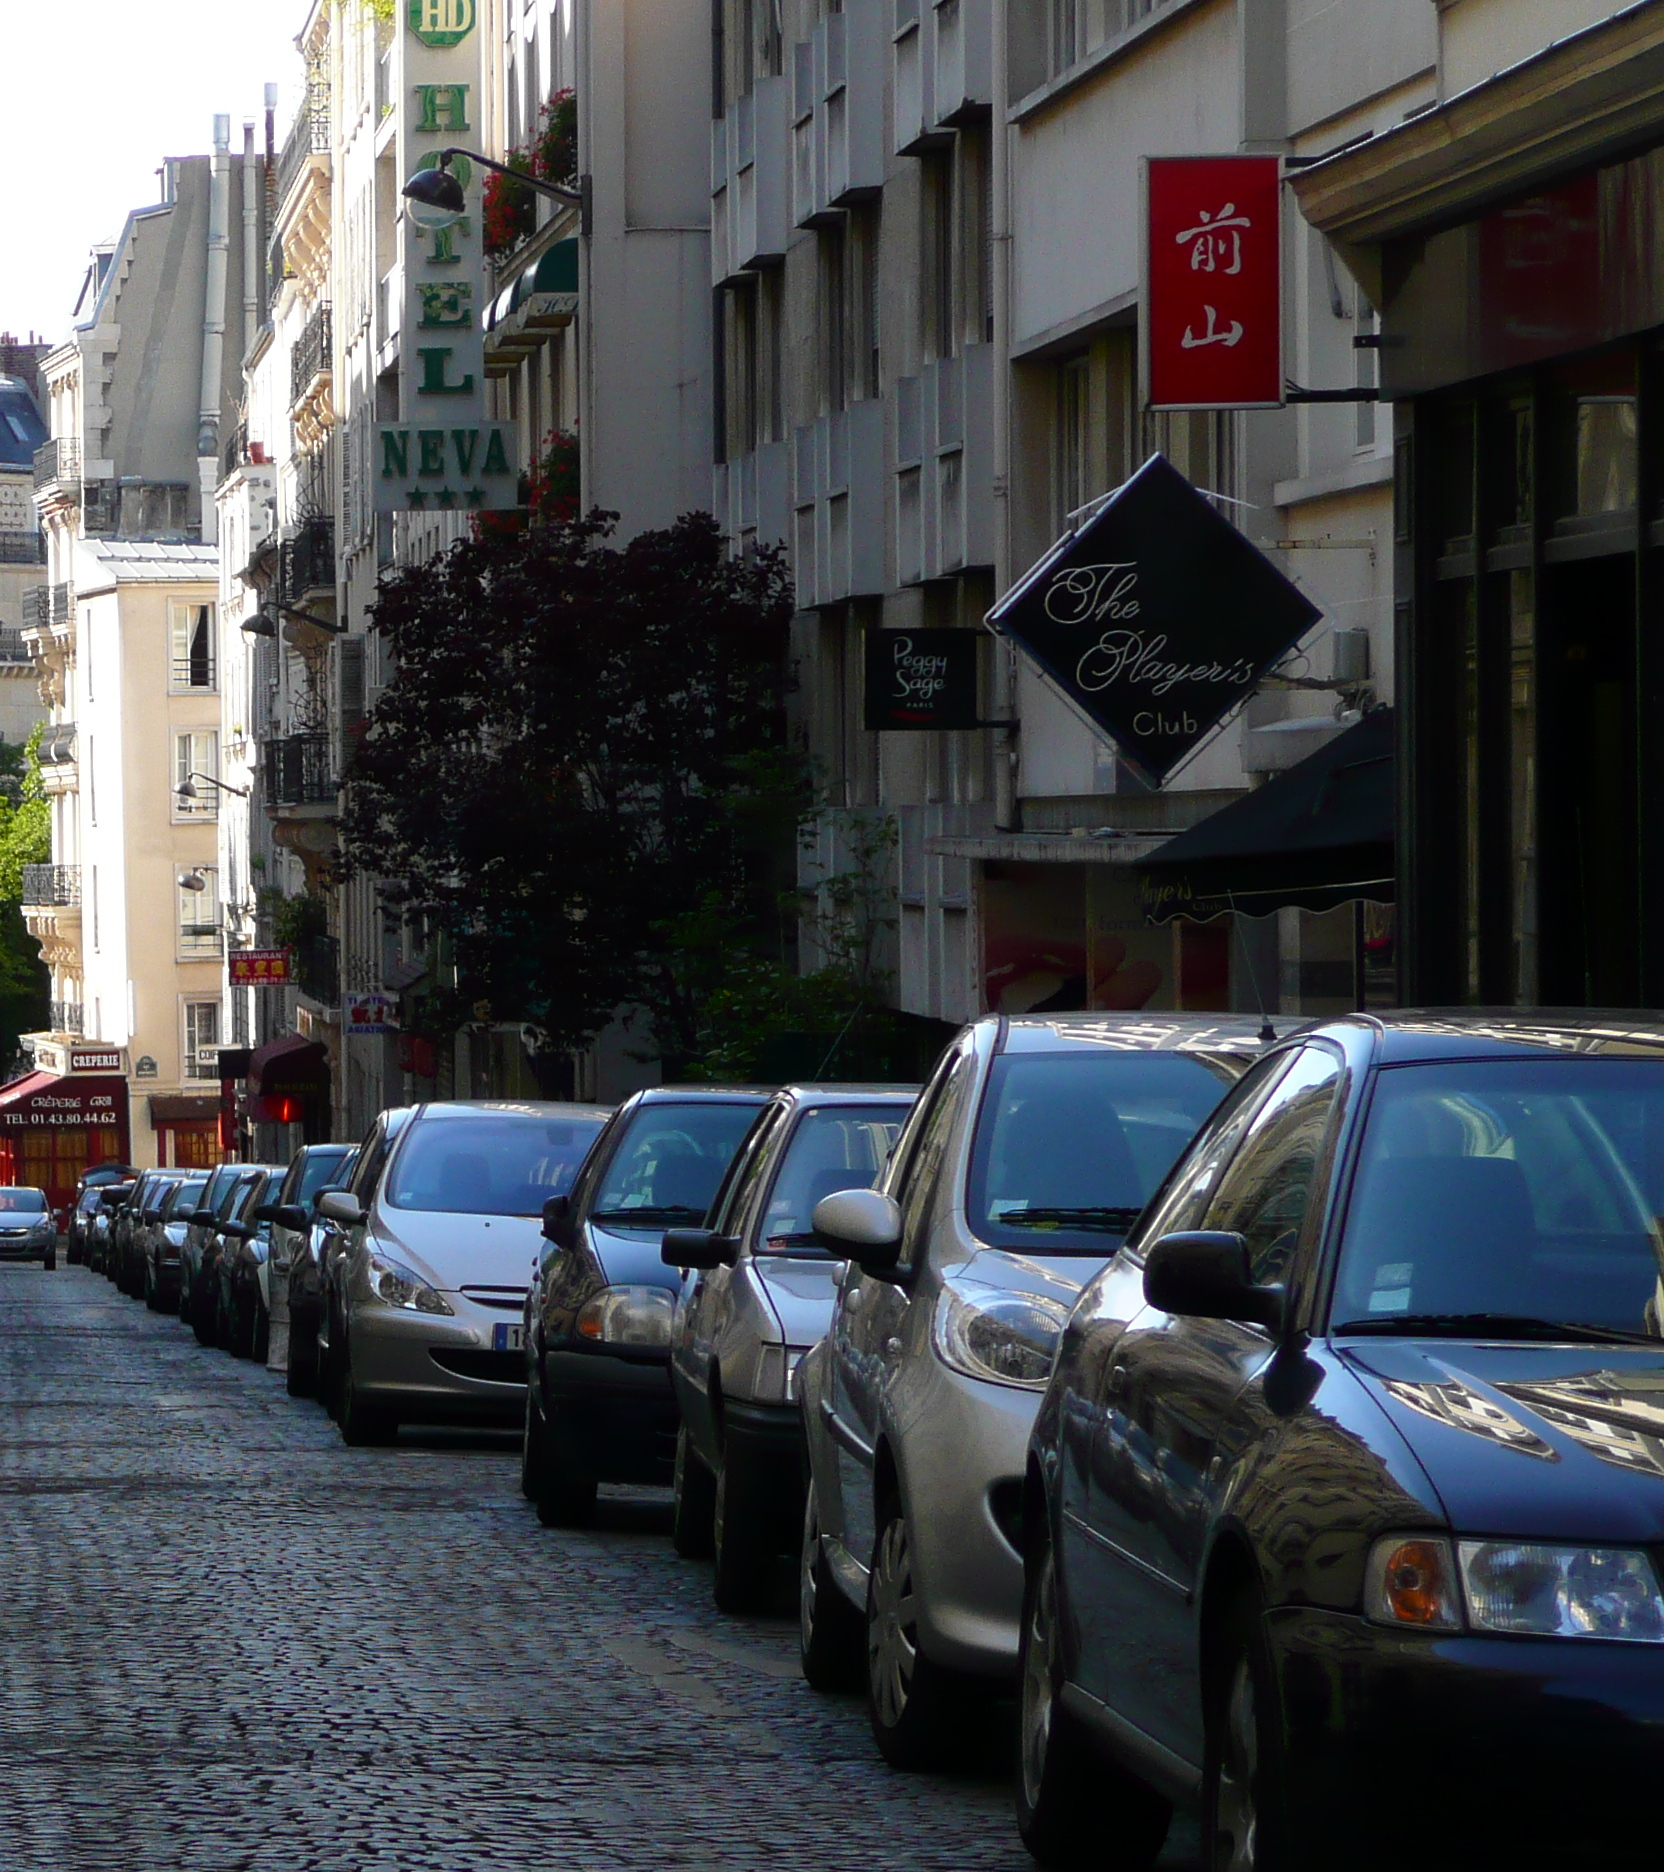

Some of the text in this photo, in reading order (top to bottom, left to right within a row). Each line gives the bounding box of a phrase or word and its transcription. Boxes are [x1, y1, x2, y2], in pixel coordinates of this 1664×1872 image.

[1175, 202, 1252, 349] 前山
[381, 428, 510, 477] NEVA
[1044, 561, 1142, 624] The
[892, 636, 949, 677] Peggy
[1076, 629, 1256, 697] Player's
[892, 669, 946, 700] Sage
[1132, 711, 1198, 736] Club
[72, 1054, 119, 1067] CREPERIE
[31, 1112, 116, 1125] 01.43.80.44.62
